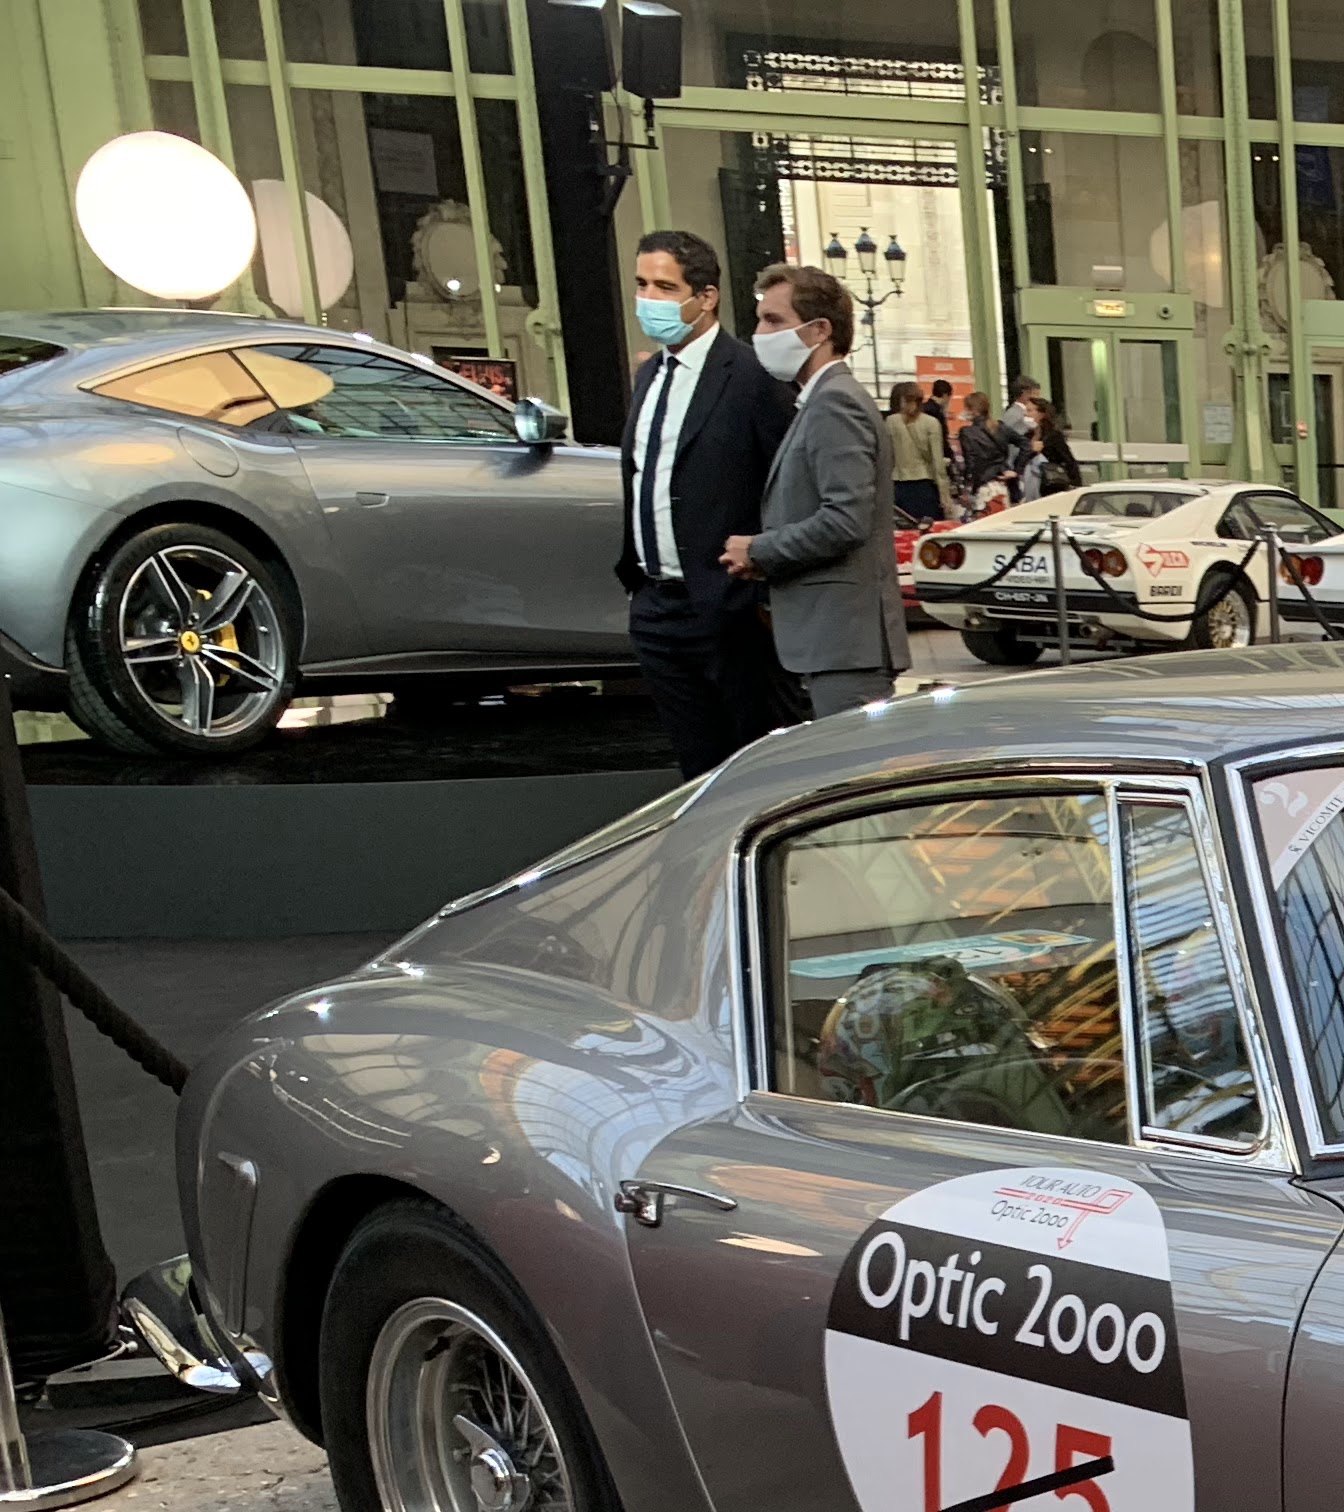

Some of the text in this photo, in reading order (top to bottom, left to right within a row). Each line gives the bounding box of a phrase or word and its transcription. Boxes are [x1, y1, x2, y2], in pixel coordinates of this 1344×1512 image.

[1020, 1174, 1102, 1199] TOUR AUTO
[990, 1199, 1069, 1228] Optic 2000
[858, 1230, 1167, 1375] Optic 2000
